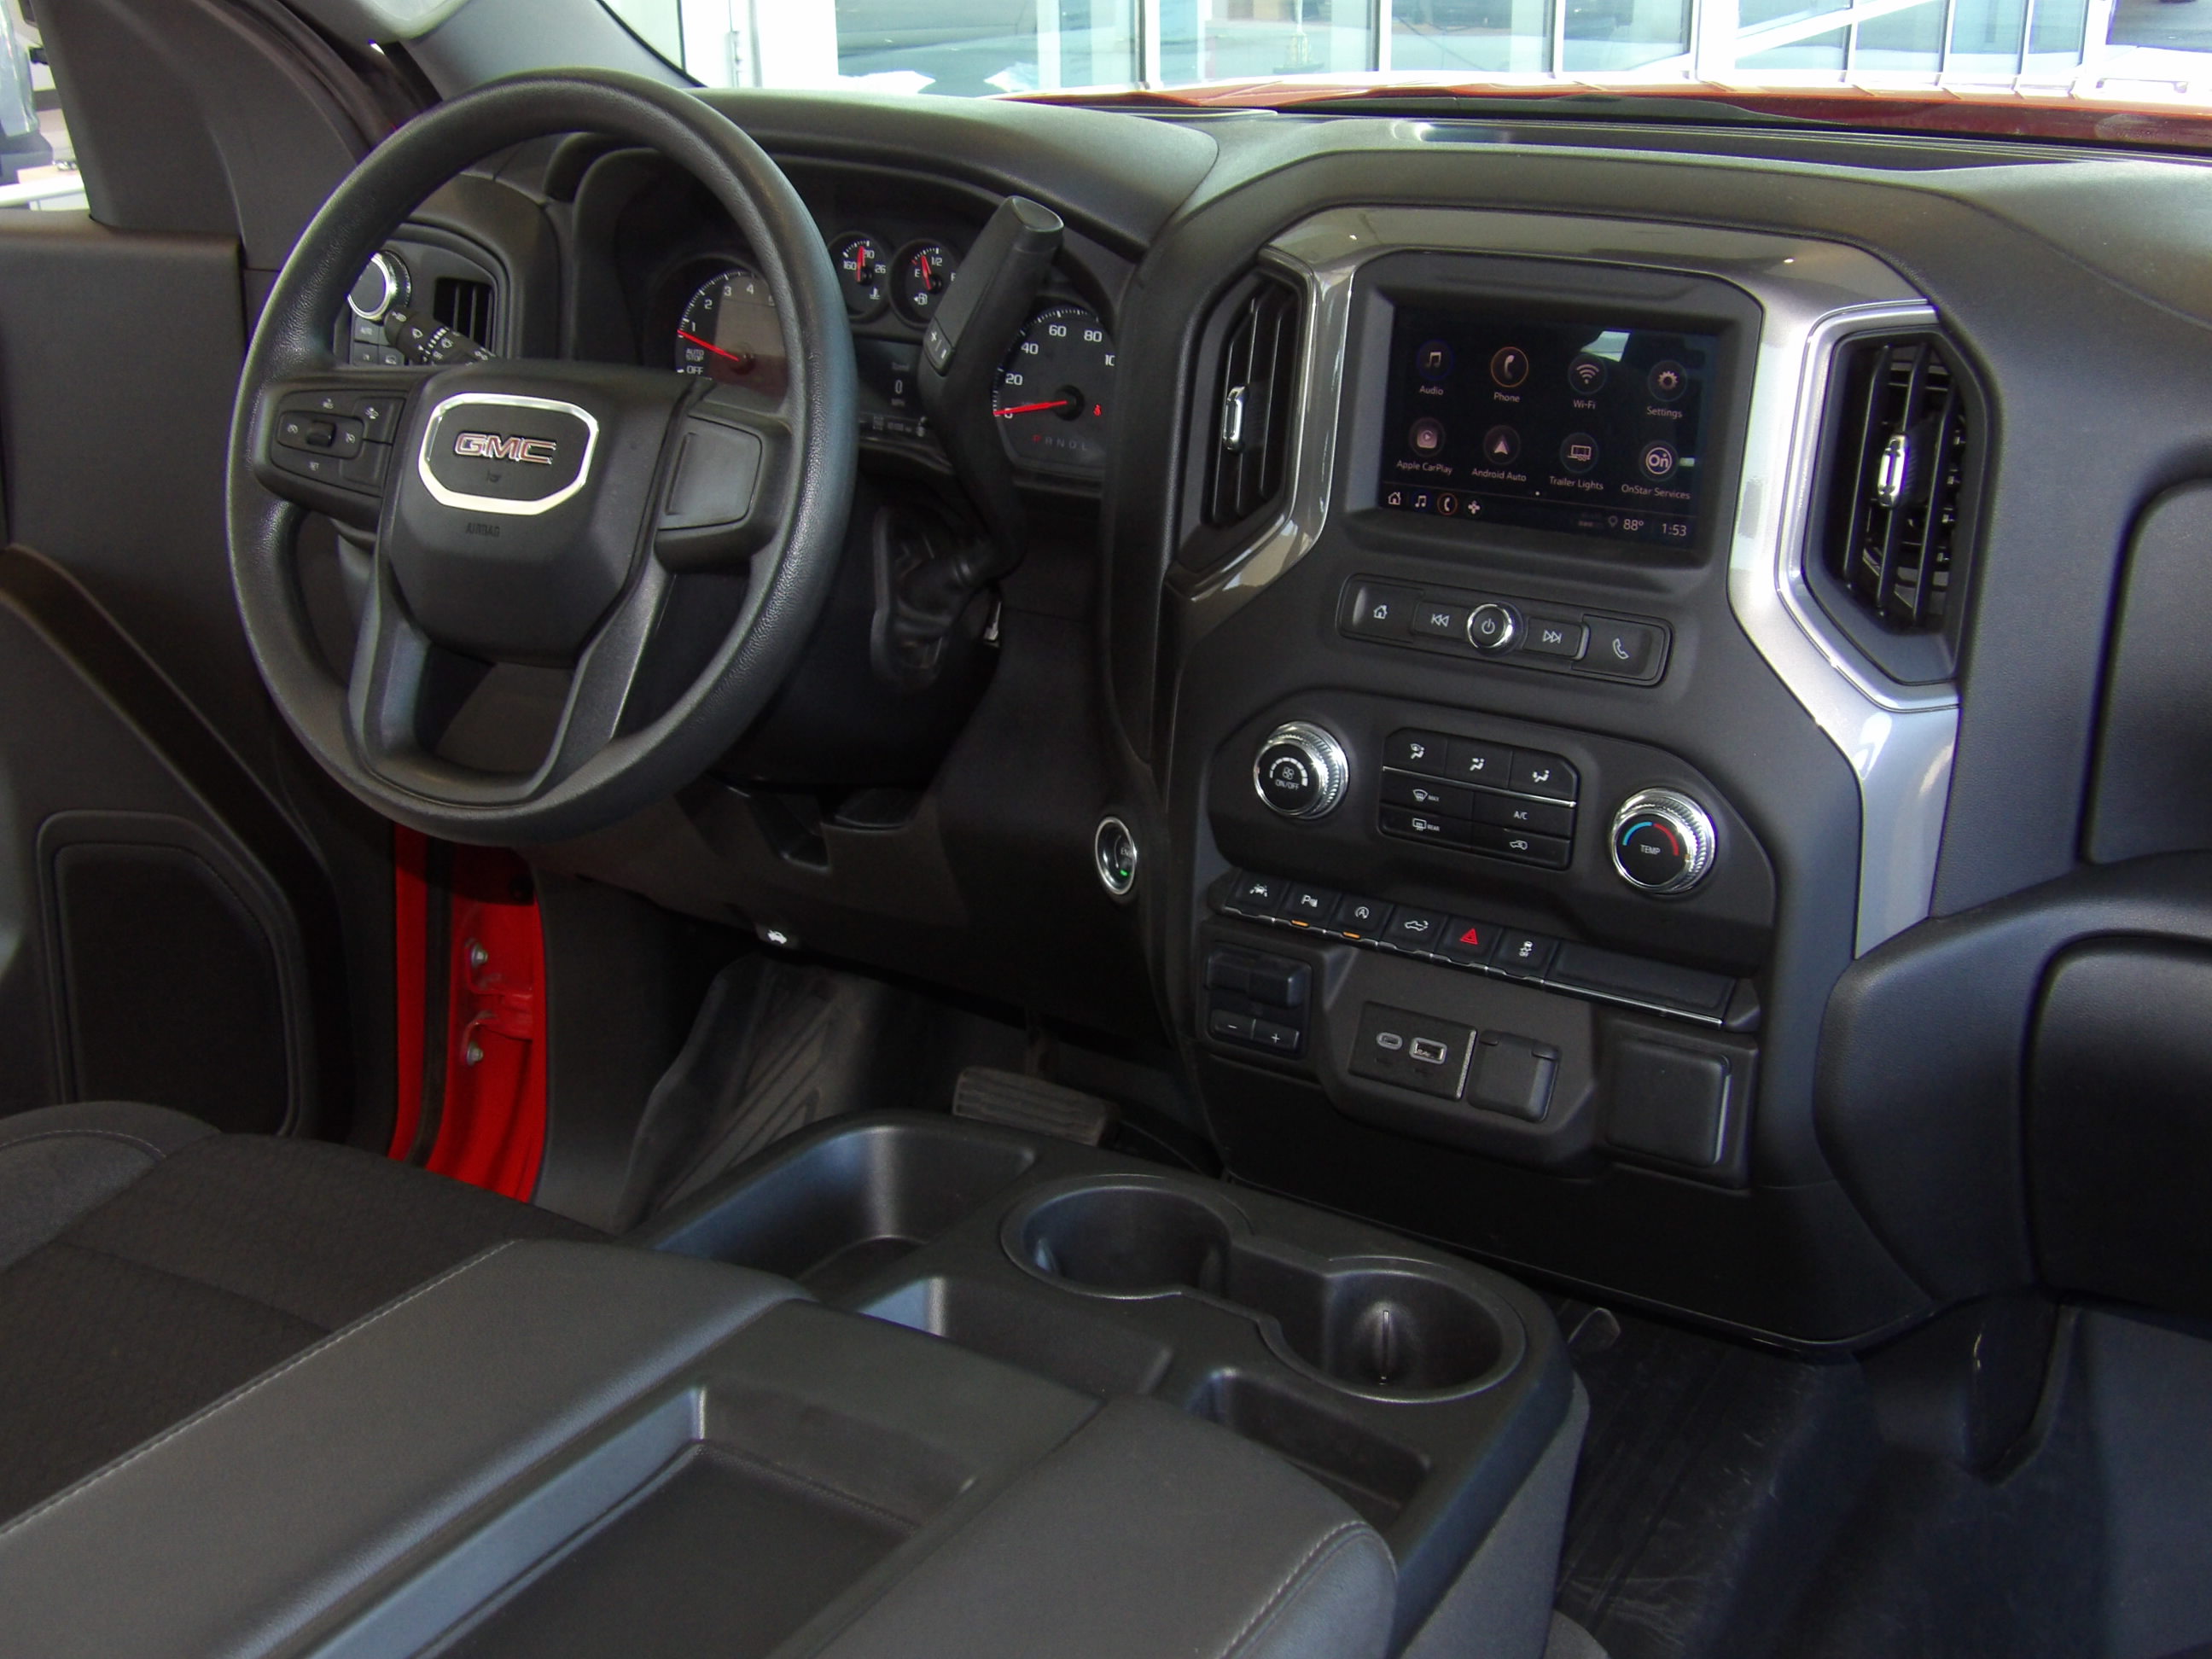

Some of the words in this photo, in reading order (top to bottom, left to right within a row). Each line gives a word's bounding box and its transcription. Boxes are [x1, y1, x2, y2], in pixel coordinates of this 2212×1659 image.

[843, 260, 857, 271] 160
[931, 257, 943, 267] 1/2
[914, 269, 920, 278] E
[724, 286, 732, 297] 3
[746, 283, 754, 294] 4
[704, 299, 713, 310] 2
[691, 322, 696, 332] 1
[1049, 324, 1067, 337] 60
[1084, 329, 1102, 342] 80
[1021, 342, 1039, 355] 40
[686, 365, 704, 375] OFF
[1005, 373, 1023, 386] 20
[894, 379, 903, 394] 0
[1419, 386, 1444, 396] Audio
[1493, 392, 1520, 403] Phone
[1574, 399, 1596, 410] Wi-Fi
[1646, 406, 1683, 419] Settings
[455, 432, 556, 464] GMC
[1396, 460, 1420, 472] Apple
[1423, 463, 1452, 475] CarPlay
[1471, 469, 1505, 480] Android
[1506, 471, 1527, 482] Auto
[1549, 476, 1575, 486] Trailer
[1578, 479, 1604, 492] Lights
[1621, 484, 1652, 496] OnStar
[1654, 487, 1691, 499] Services
[1623, 519, 1644, 532] 88°
[1662, 523, 1687, 536] 1:53
[1275, 778, 1300, 790] ON/OFF
[1513, 811, 1528, 820] A/C
[1640, 844, 1661, 855] TEMP
